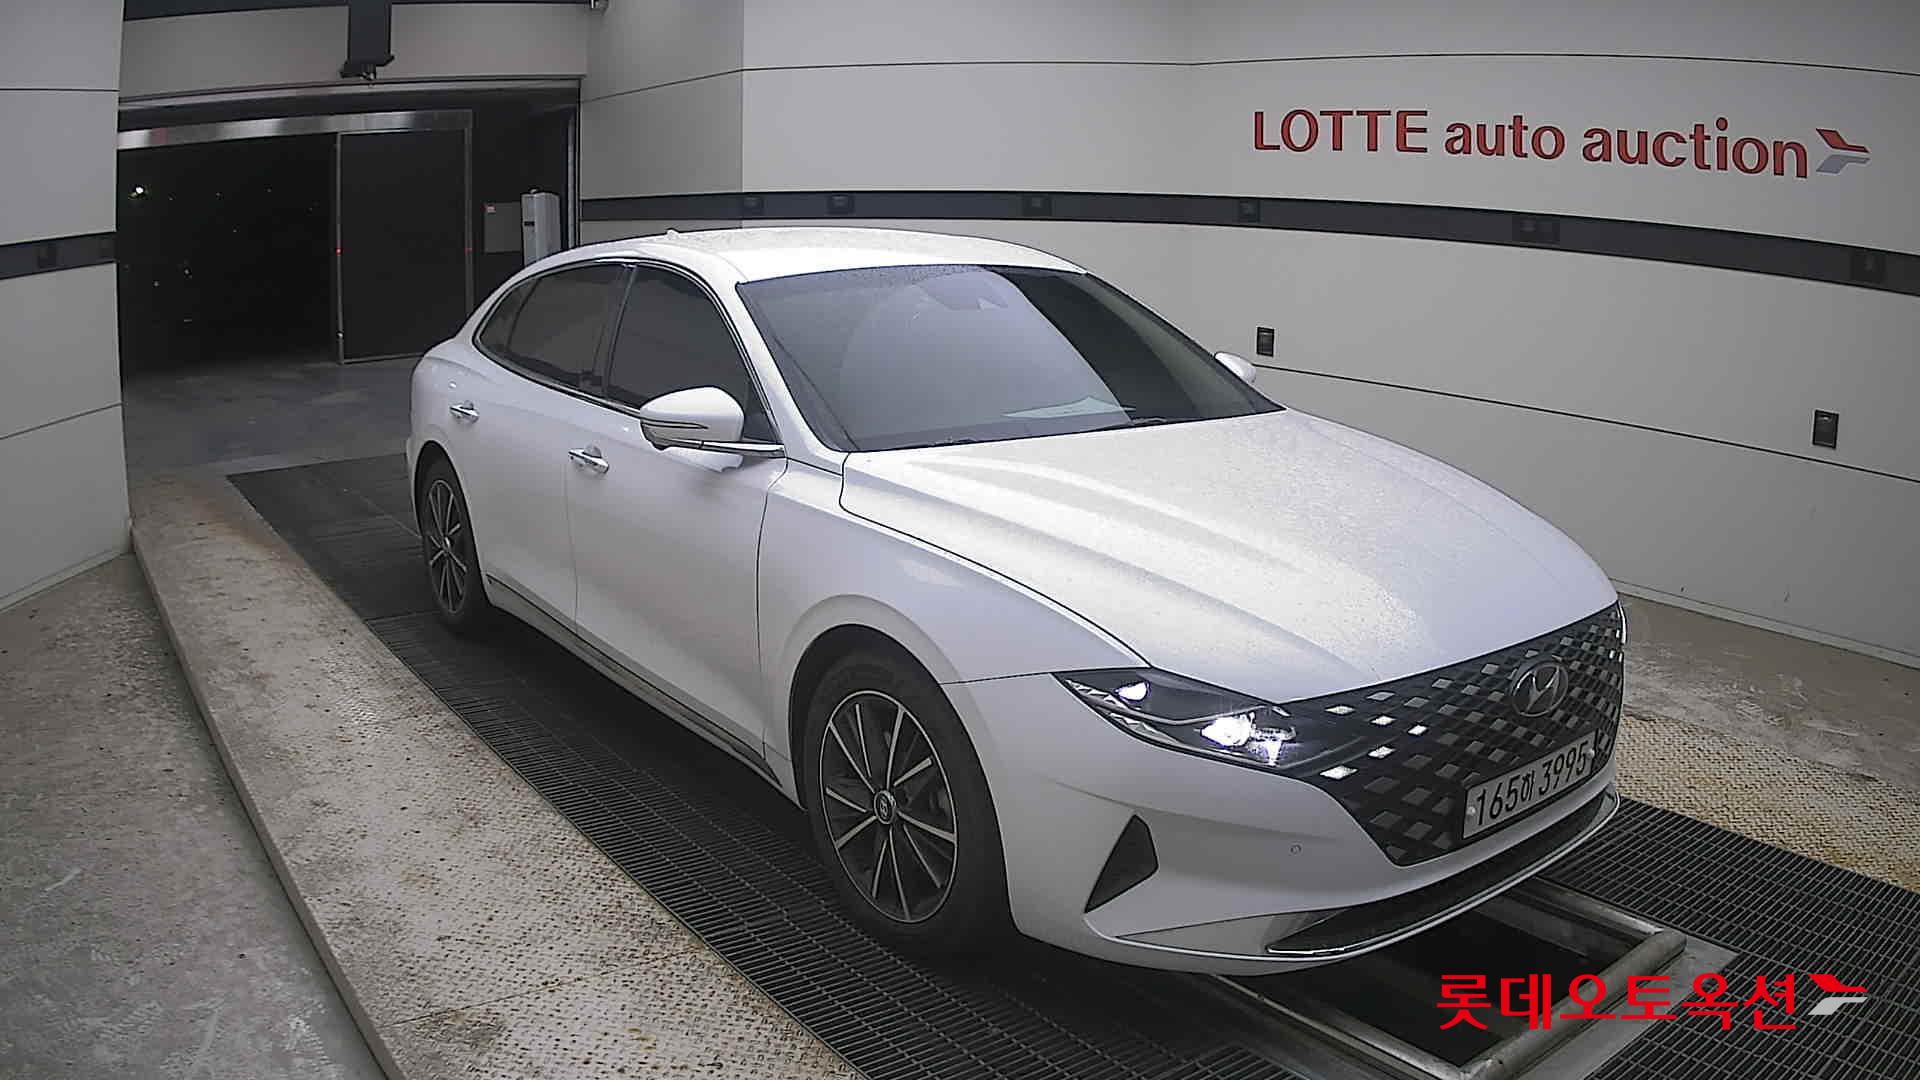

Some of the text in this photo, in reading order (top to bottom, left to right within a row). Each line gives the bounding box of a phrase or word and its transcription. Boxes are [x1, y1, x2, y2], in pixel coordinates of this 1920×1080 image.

[1254, 110, 1808, 178] LOTTE auto auction
[1539, 741, 1588, 795] 3995
